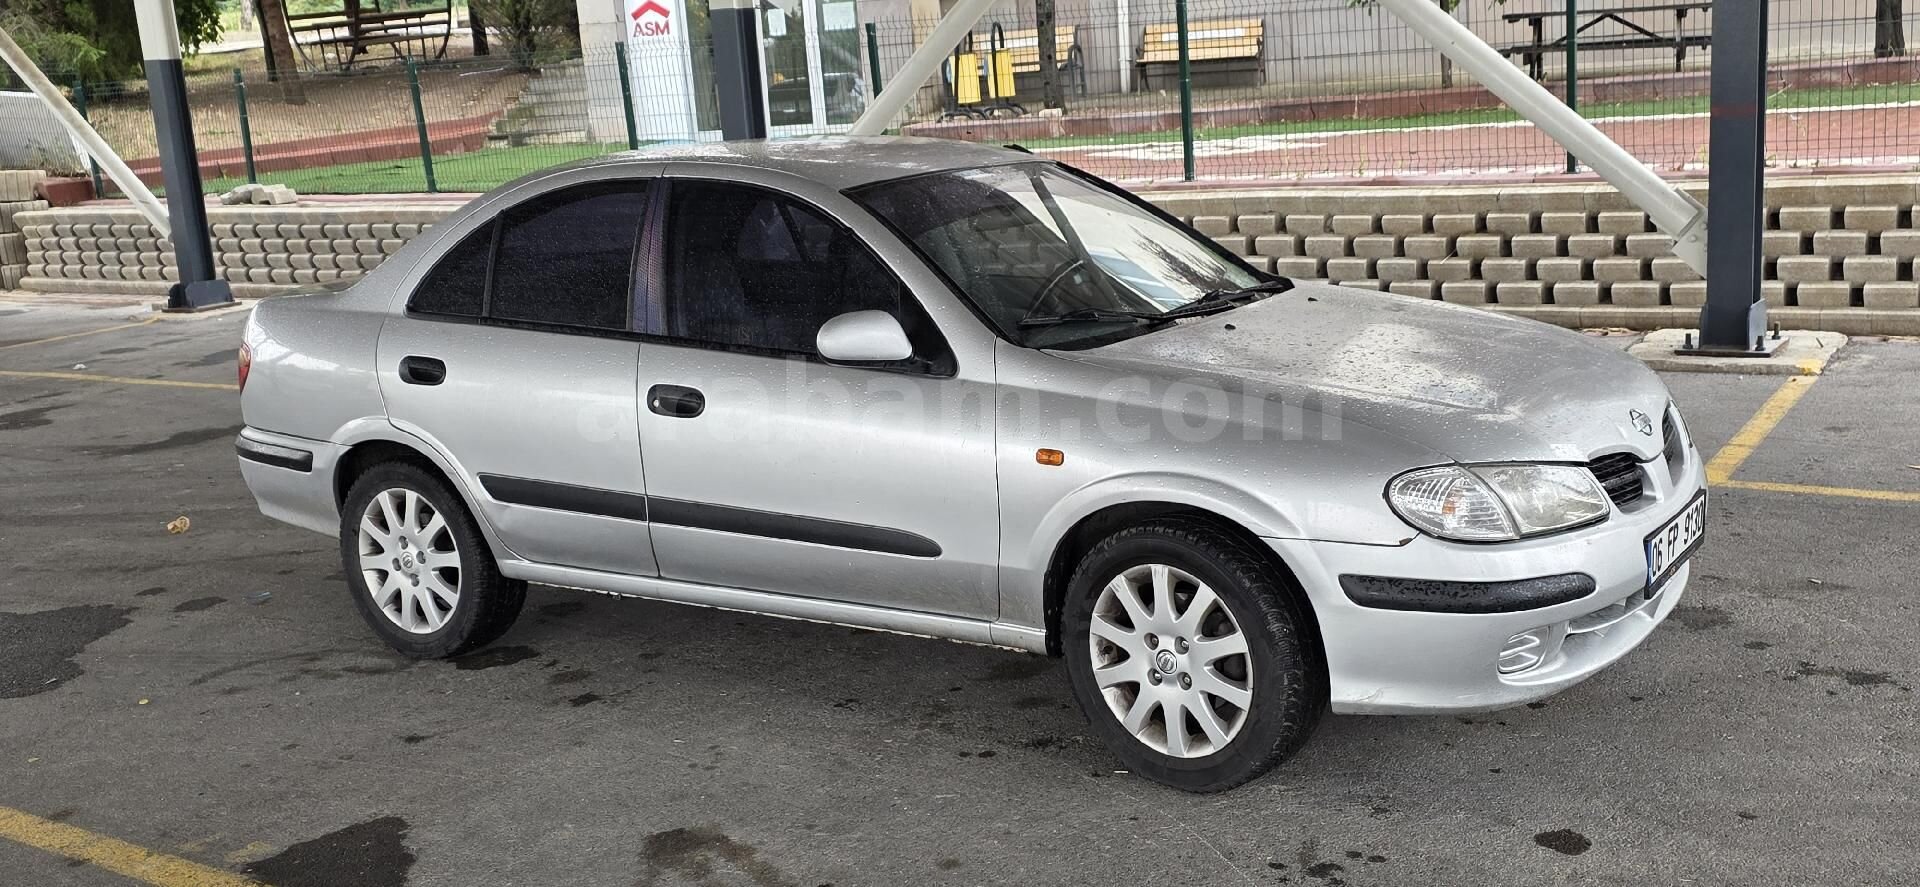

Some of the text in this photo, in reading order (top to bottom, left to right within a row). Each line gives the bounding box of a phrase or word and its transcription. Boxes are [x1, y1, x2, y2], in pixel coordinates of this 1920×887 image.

[633, 20, 670, 38] ASM
[1652, 537, 1663, 577] 06
[1667, 522, 1679, 562] FP
